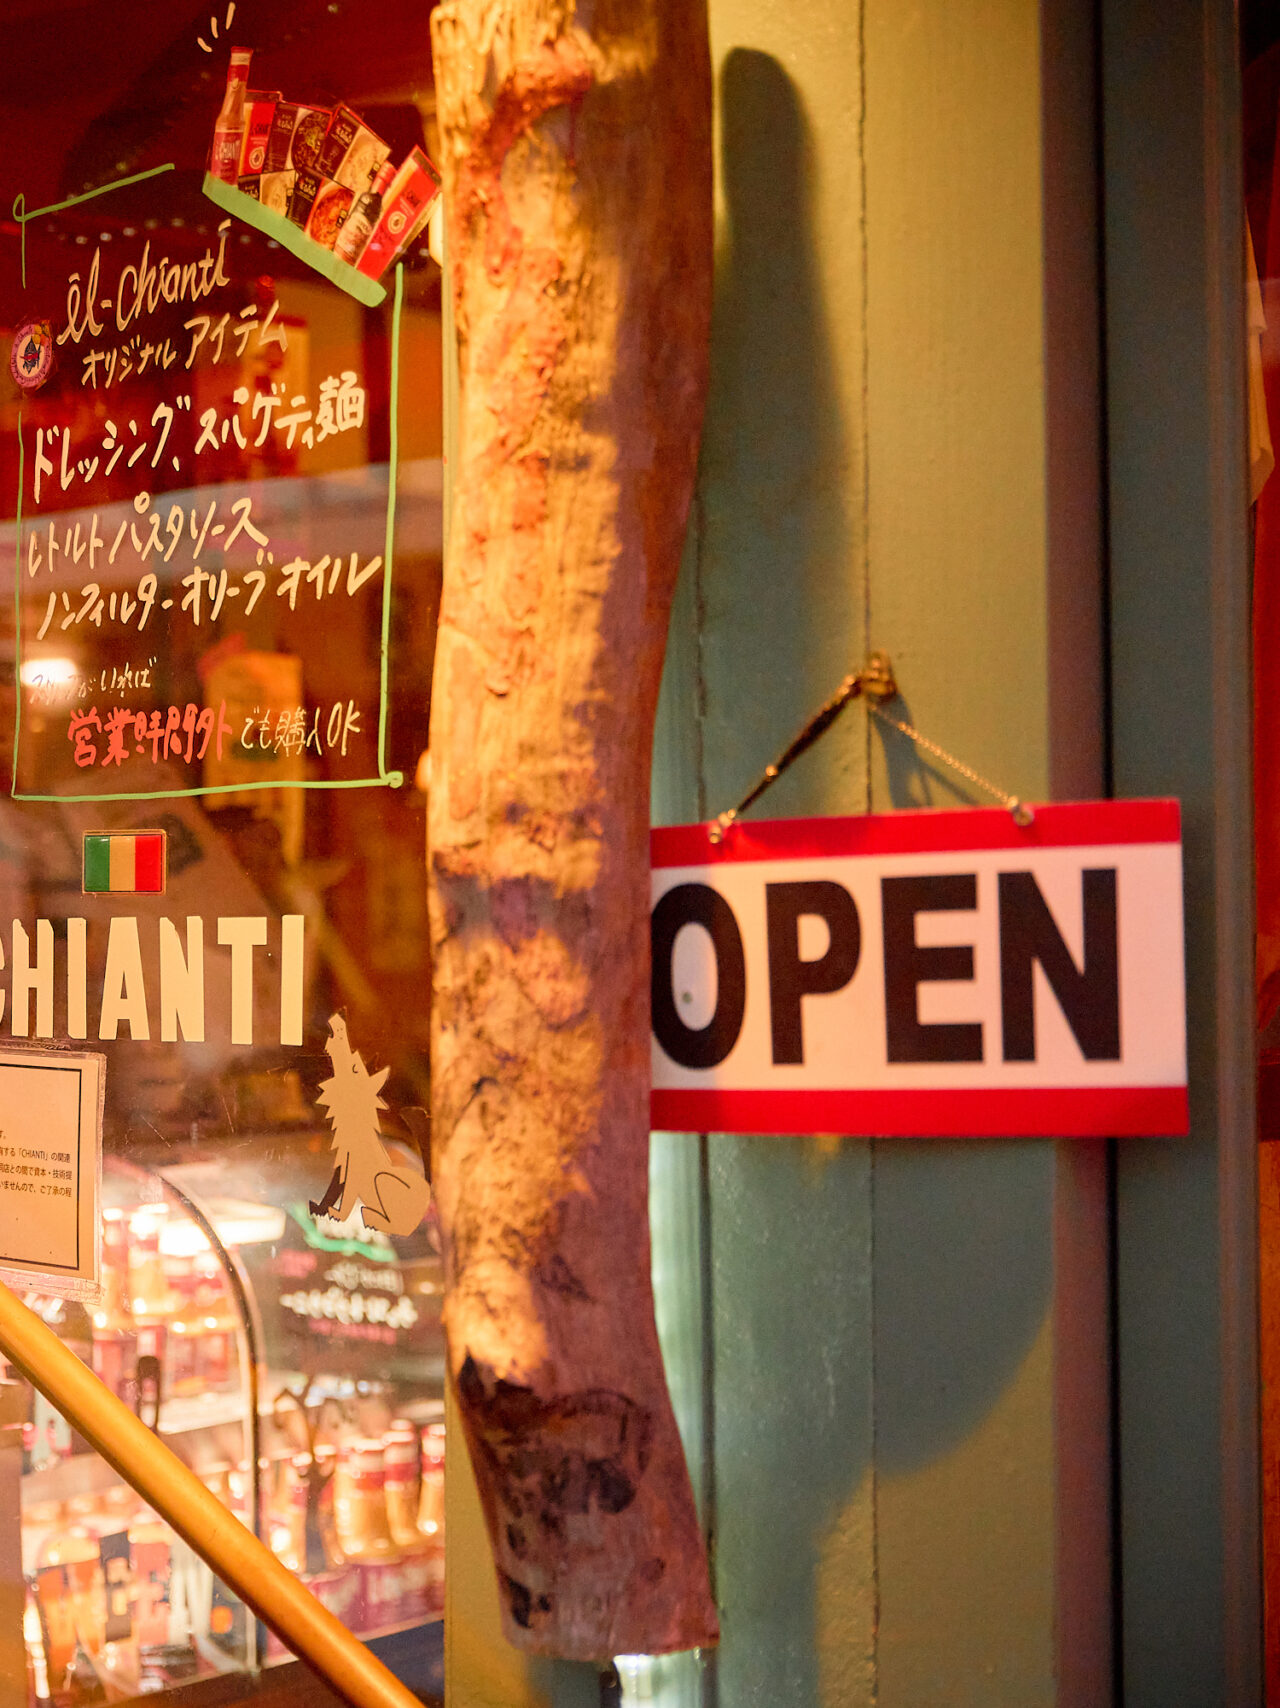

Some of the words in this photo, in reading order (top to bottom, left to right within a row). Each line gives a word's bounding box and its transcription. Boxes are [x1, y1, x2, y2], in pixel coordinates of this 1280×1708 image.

[81, 334, 177, 390] オリジナル
[183, 301, 288, 370] アイテム
[651, 867, 1123, 1070] OPEN
